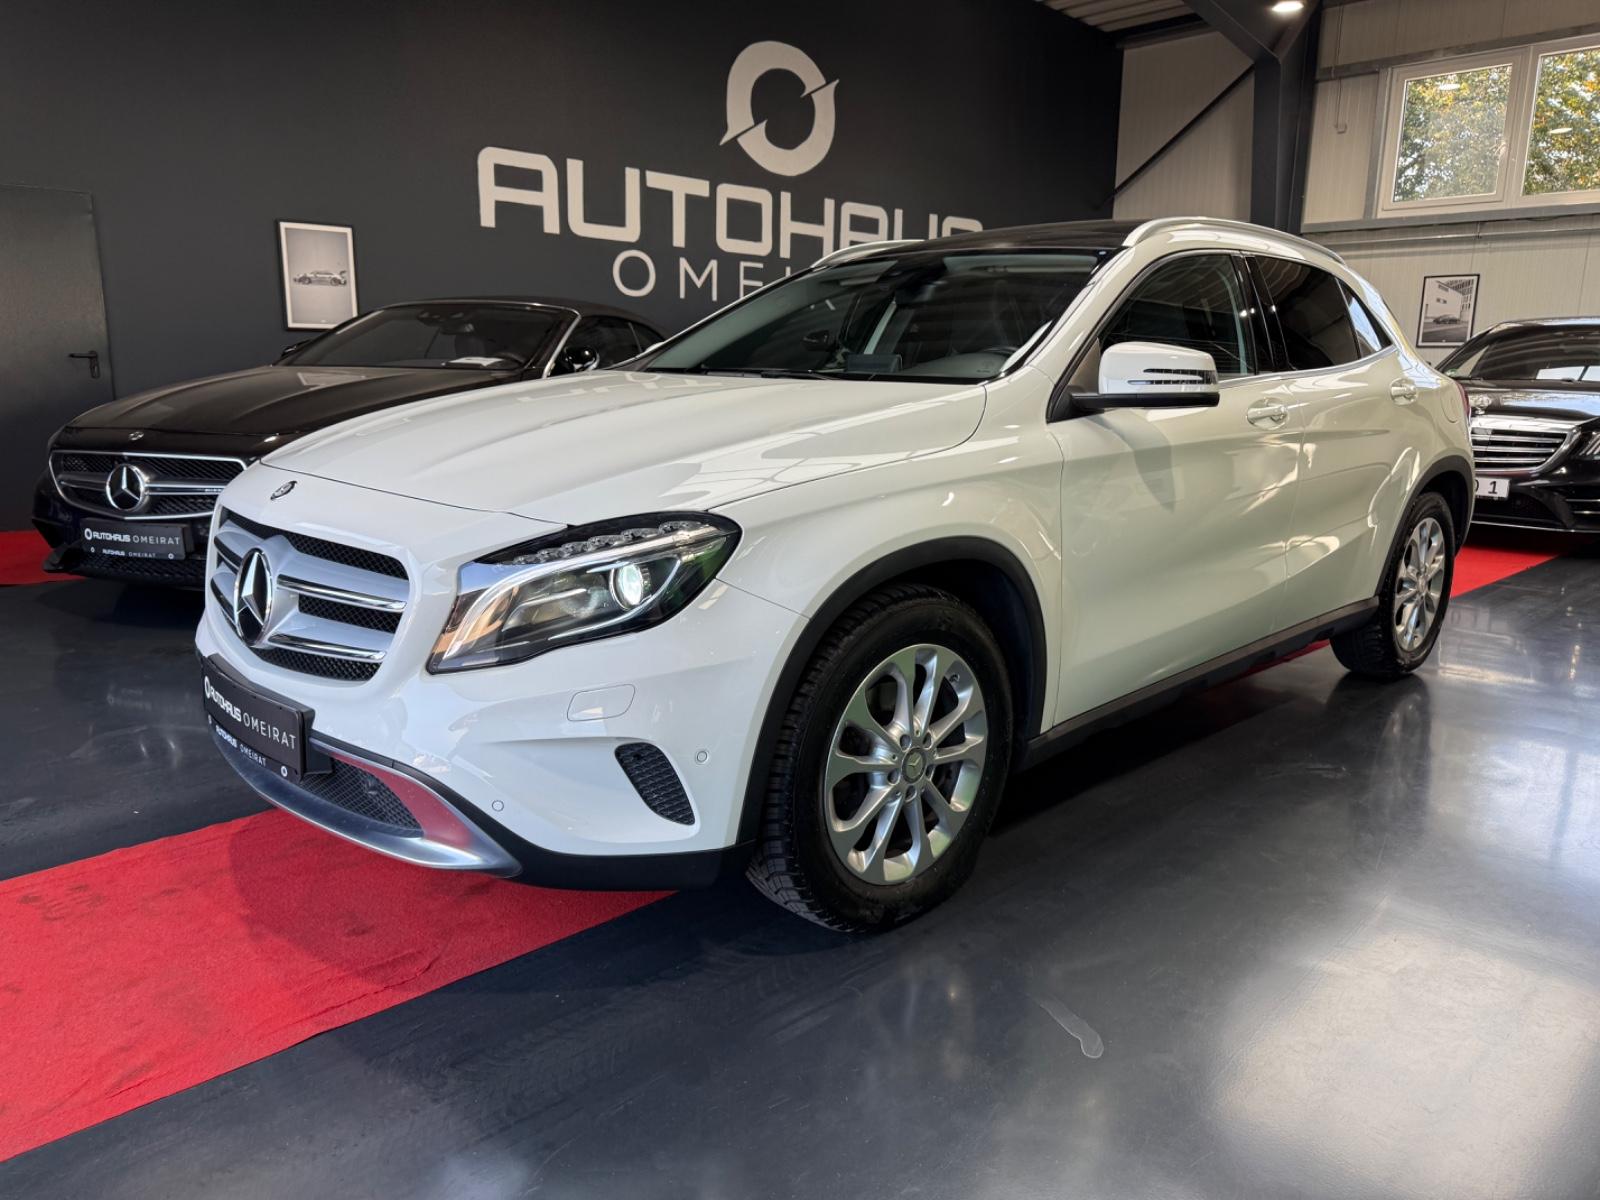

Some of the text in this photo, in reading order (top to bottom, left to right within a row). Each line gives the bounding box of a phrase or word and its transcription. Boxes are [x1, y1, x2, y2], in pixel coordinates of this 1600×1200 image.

[612, 250, 791, 301] OME
[1488, 481, 1498, 494] 1
[92, 531, 180, 545] AUTOHAUS OMEIRAT
[243, 712, 296, 750] OMEIRAT
[239, 743, 267, 767] OMEIRAT
